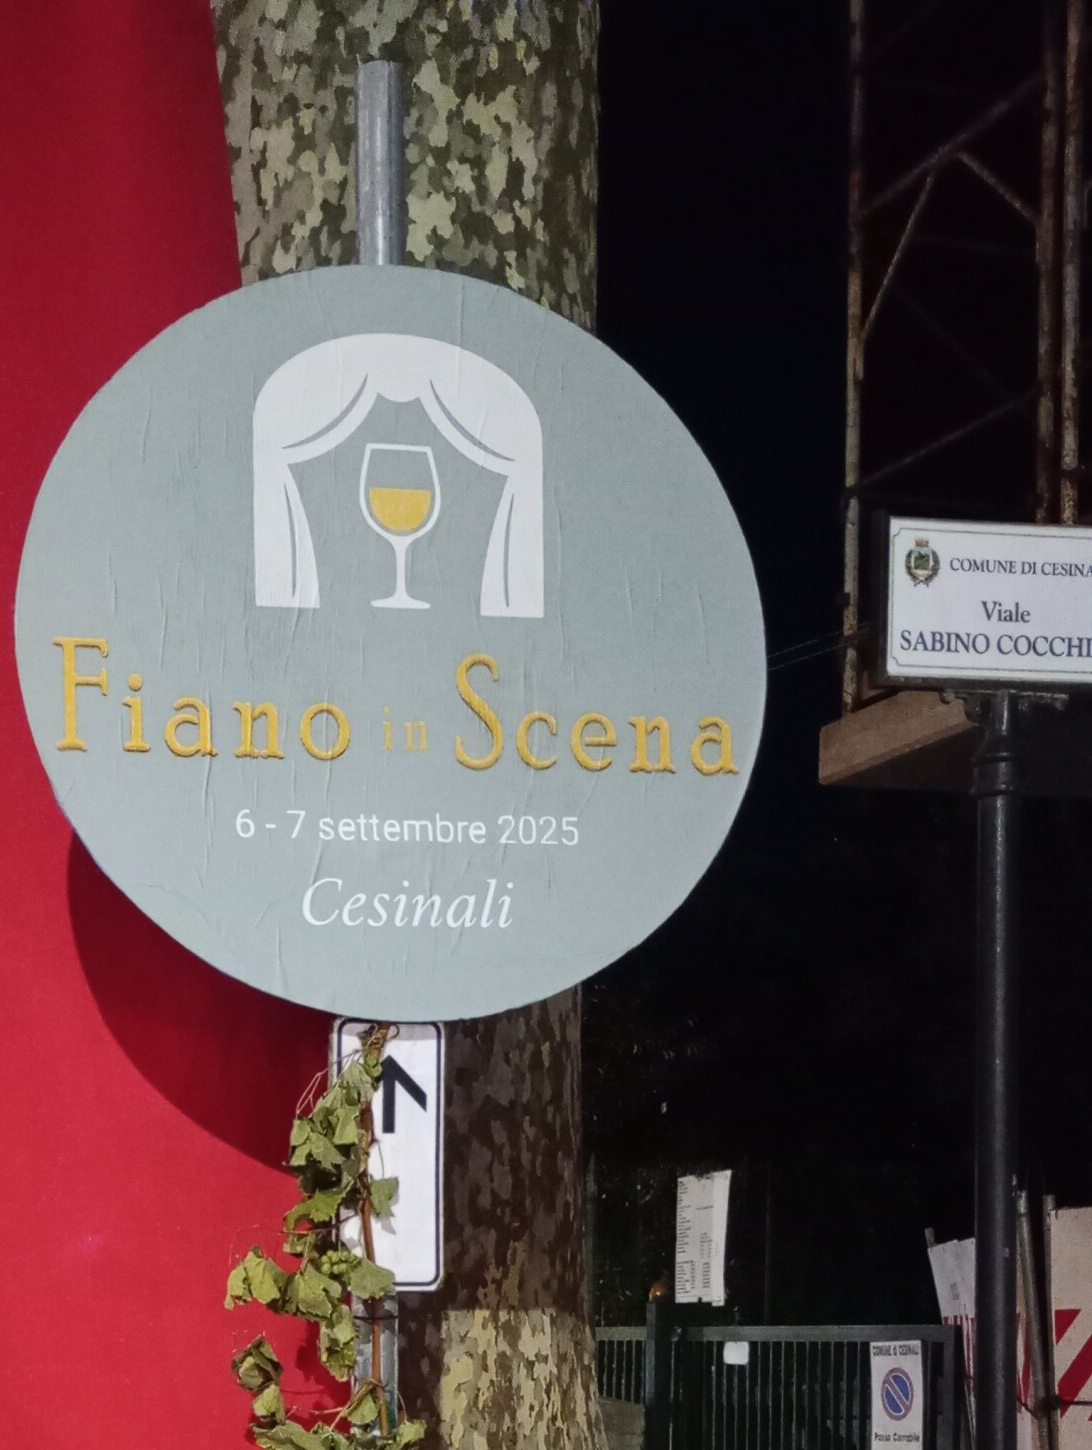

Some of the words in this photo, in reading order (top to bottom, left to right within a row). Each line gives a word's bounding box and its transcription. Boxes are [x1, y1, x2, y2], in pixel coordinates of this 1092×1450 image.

[949, 557, 1017, 574] COMUNE
[1021, 561, 1037, 575] DI
[981, 601, 1031, 623] Viale
[900, 629, 990, 654] SABINO
[54, 637, 350, 760] Fiano
[381, 708, 429, 752] in
[455, 653, 739, 775] Scena
[235, 810, 255, 838] 6
[287, 811, 305, 840] 7
[318, 812, 487, 844] settembre
[499, 815, 580, 846] 2025
[302, 878, 514, 928] Cesinali
